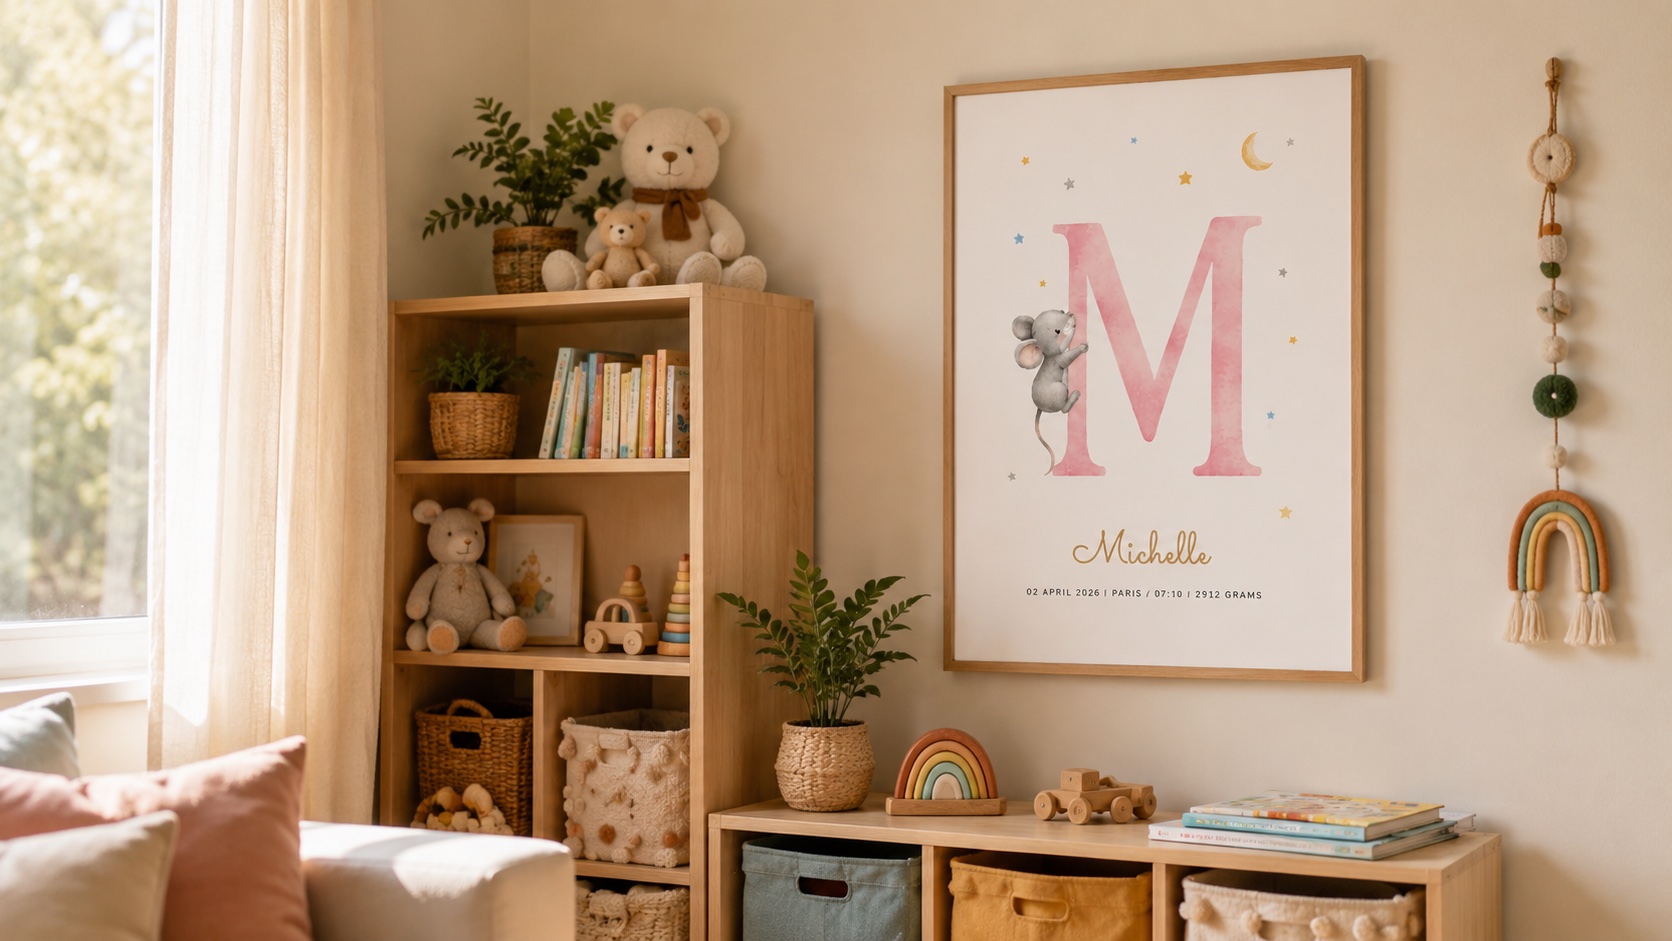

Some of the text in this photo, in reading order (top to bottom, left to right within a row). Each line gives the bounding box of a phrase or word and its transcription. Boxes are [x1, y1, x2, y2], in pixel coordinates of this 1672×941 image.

[1053, 216, 1262, 476] M
[1072, 528, 1213, 564] Michelle
[1026, 587, 1038, 596] 02
[1042, 588, 1072, 597] APRIL
[1075, 588, 1100, 597] 2026
[1111, 589, 1142, 597] PARIS
[1154, 590, 1183, 598] 07:10
[1195, 591, 1220, 599] 2912
[1224, 591, 1262, 599] GRAMS
